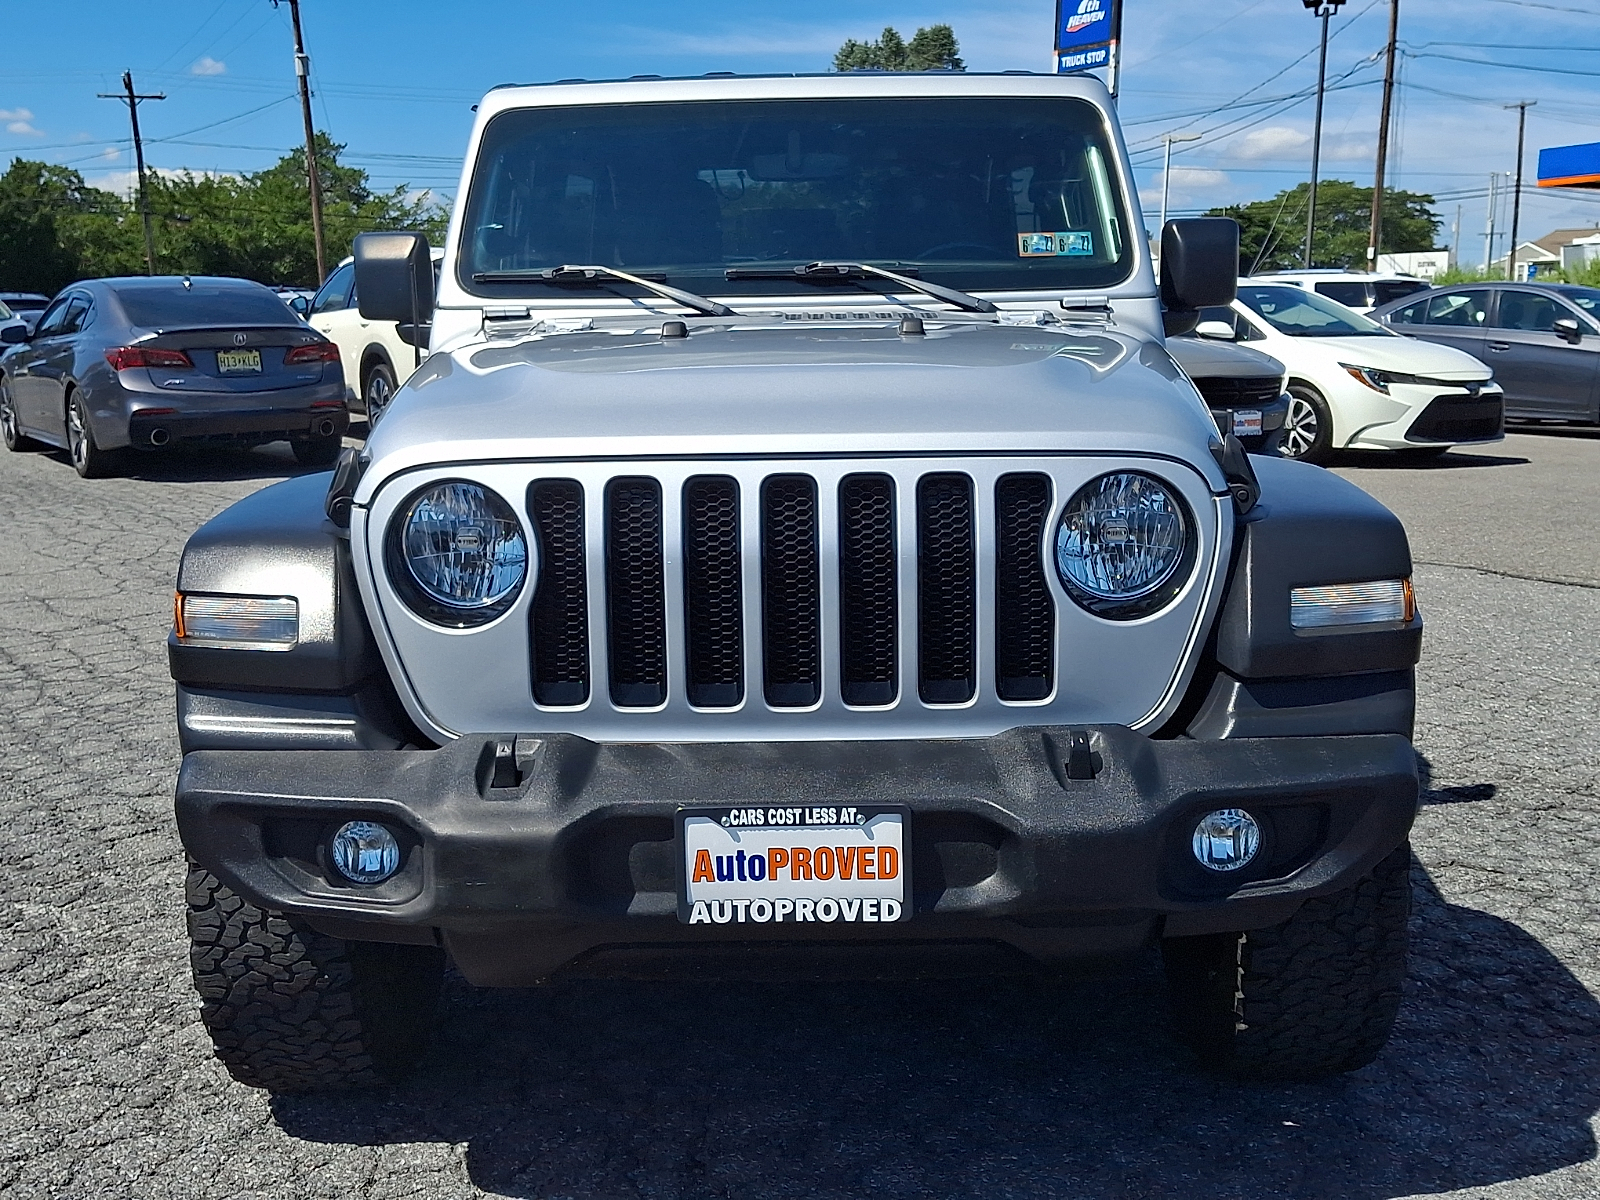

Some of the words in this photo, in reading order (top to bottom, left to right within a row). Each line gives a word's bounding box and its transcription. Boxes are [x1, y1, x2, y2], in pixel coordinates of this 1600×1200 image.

[1066, 10, 1106, 29] HEAVEN
[1061, 53, 1086, 68] TRUCK
[1086, 50, 1106, 65] STOP
[729, 809, 765, 826] CARS
[767, 808, 803, 825] COST
[805, 808, 837, 824] LESS
[839, 807, 857, 824] AT
[692, 846, 899, 882] AutoPROVED
[689, 898, 902, 924] AUTOPROVED
